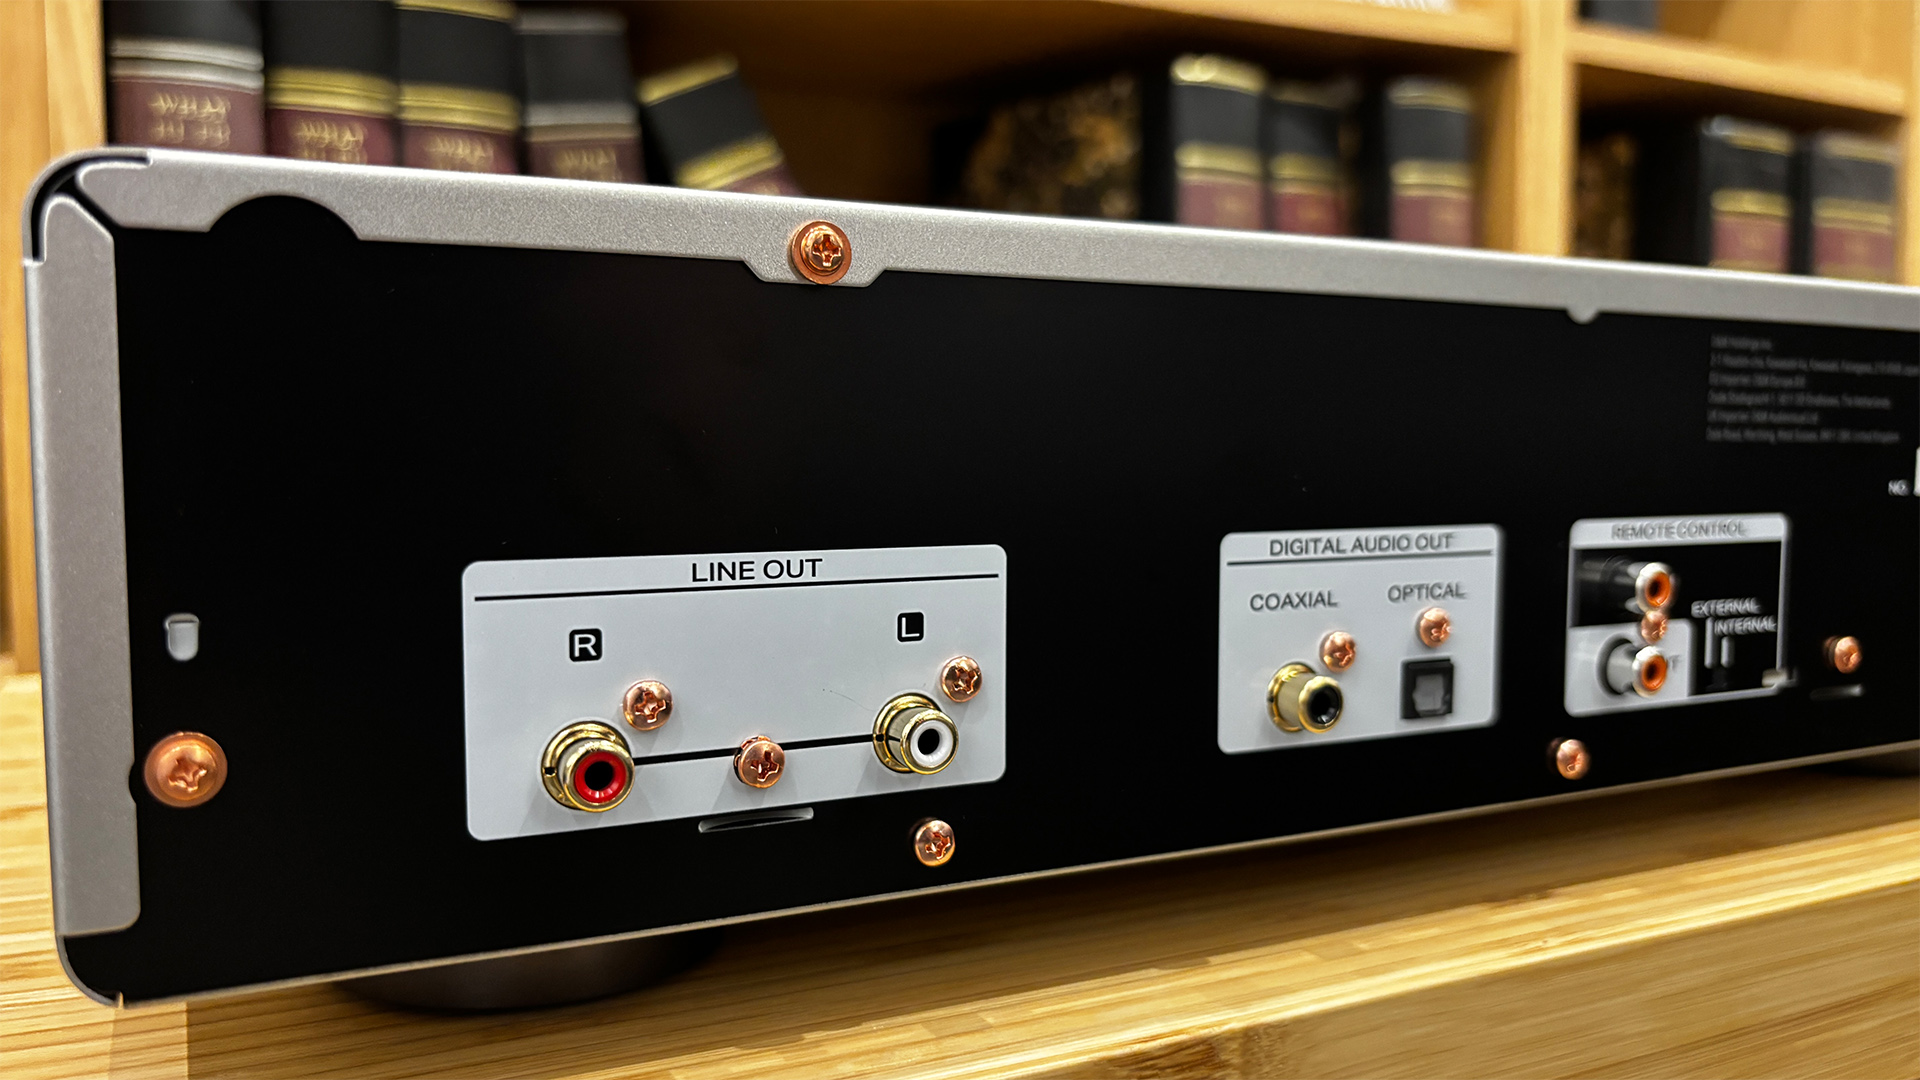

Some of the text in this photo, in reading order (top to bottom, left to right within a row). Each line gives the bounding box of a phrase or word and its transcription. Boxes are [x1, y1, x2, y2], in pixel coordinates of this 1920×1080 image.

[1611, 519, 1747, 540] REMOTE CONTROL
[1269, 532, 1455, 556] DIGITAL AUDIO OUT
[691, 558, 823, 582] LINE OUT
[1249, 590, 1339, 611] COAXIAL
[1387, 582, 1467, 603] OPTICAL
[1691, 598, 1761, 618] EXTERNAL
[900, 616, 920, 638] L
[1714, 615, 1777, 636] INTERNAL
[573, 633, 598, 658] R
